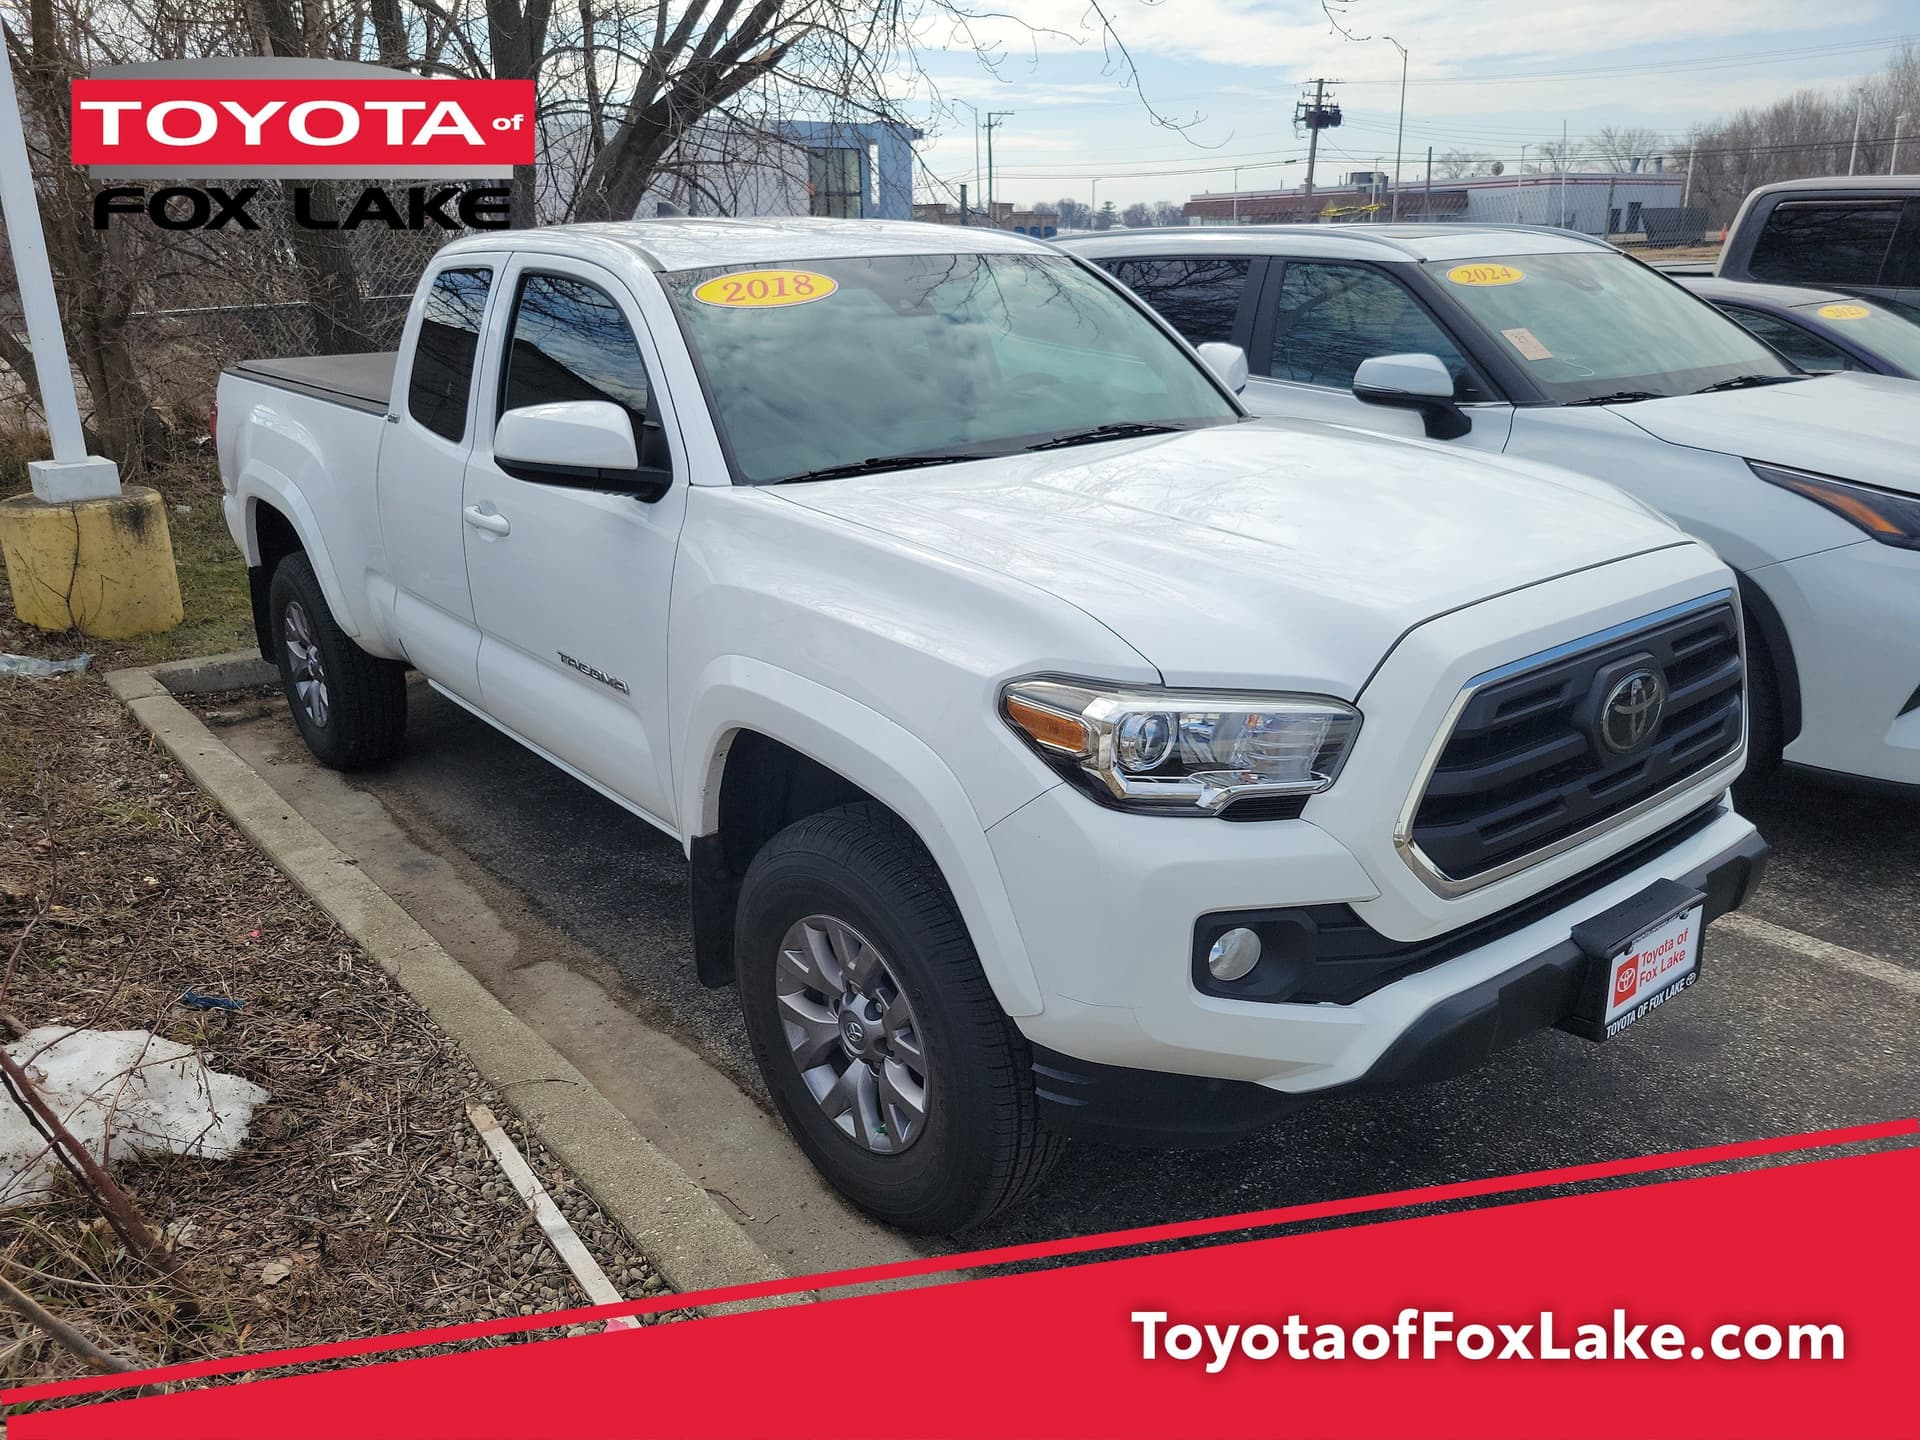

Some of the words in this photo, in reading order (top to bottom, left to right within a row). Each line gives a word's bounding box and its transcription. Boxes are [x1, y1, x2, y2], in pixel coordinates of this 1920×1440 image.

[722, 274, 815, 303] 2018
[1460, 266, 1512, 283] 2024
[557, 650, 630, 696] TACOMA
[1641, 938, 1674, 968] Toyota
[1676, 927, 1690, 945] of
[1639, 967, 1658, 987] Fox
[1660, 949, 1686, 973] Lake
[1606, 1011, 1636, 1038] TOYOTA
[1637, 1001, 1649, 1019] OF
[1649, 993, 1665, 1011] FOX
[1665, 978, 1685, 999] LAKE
